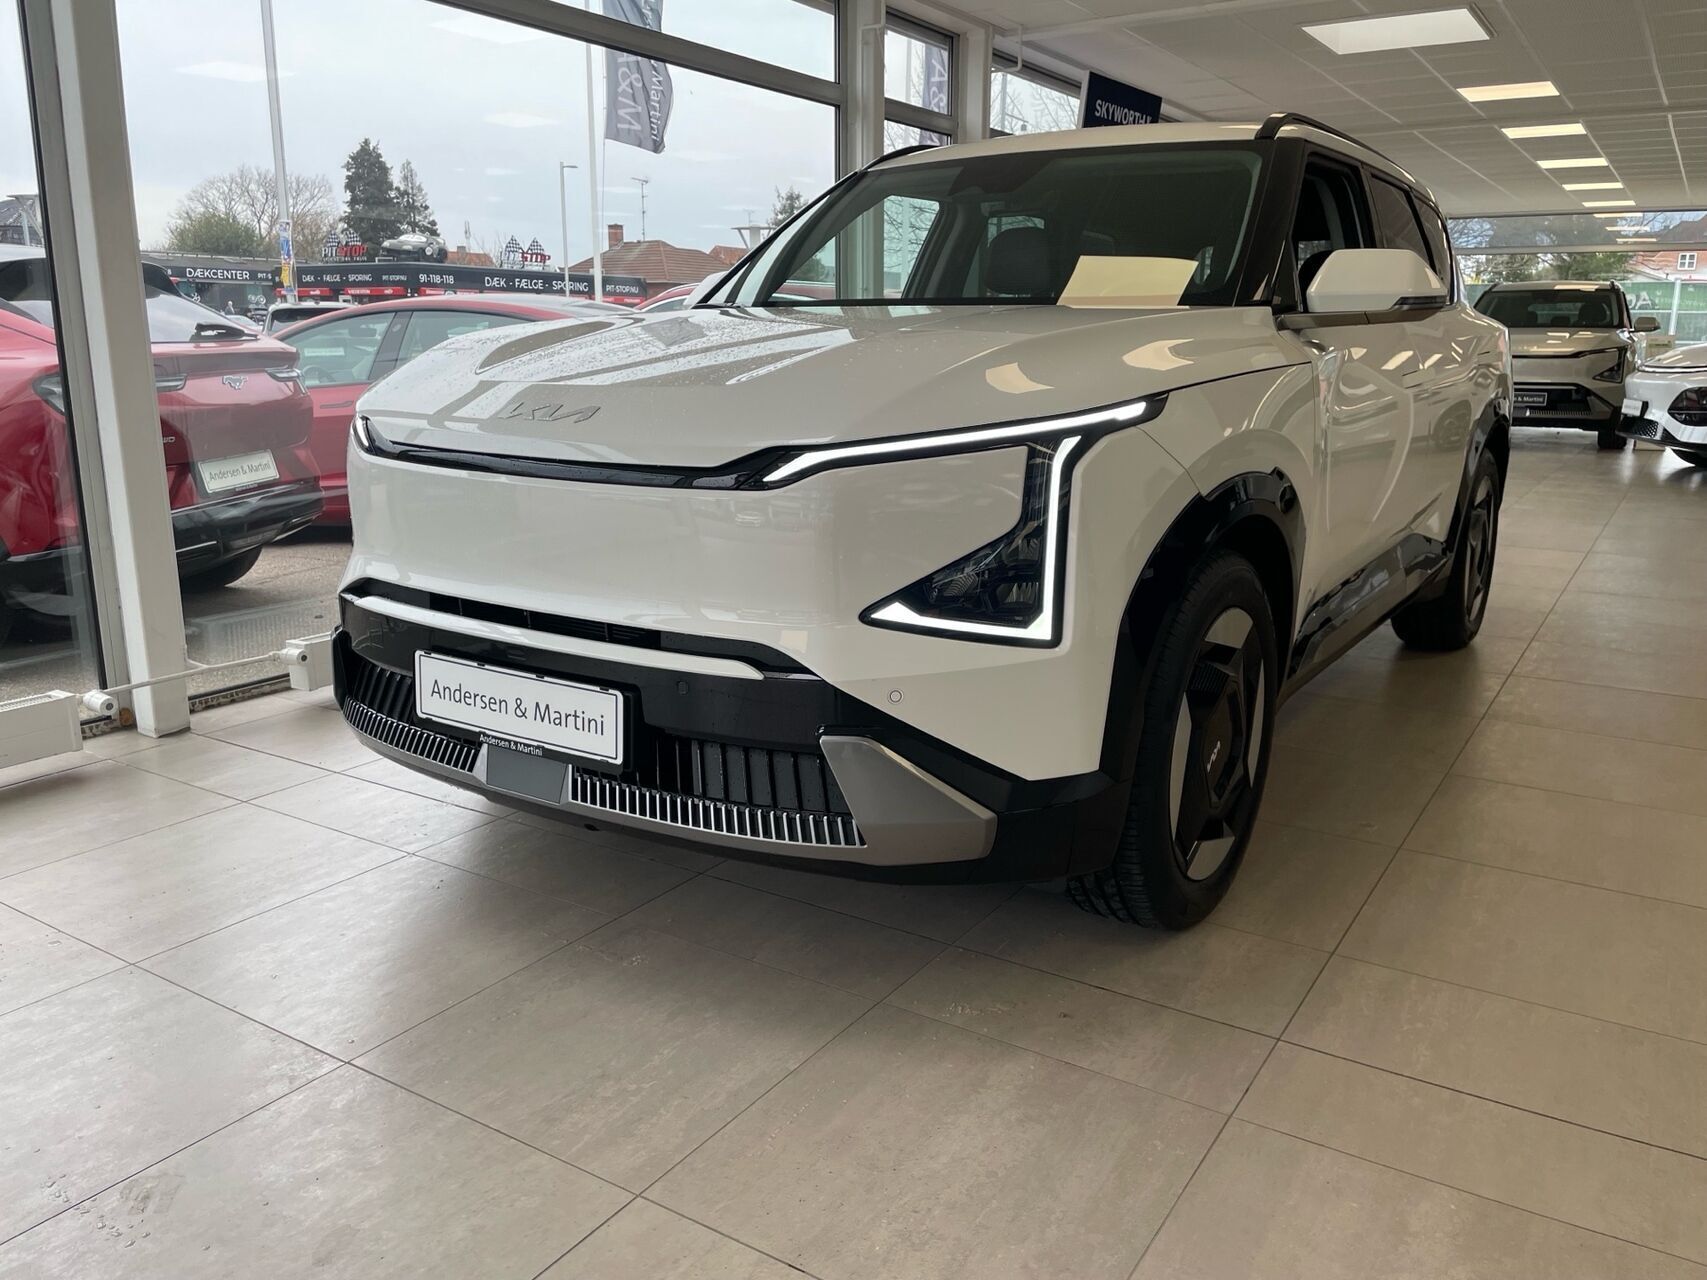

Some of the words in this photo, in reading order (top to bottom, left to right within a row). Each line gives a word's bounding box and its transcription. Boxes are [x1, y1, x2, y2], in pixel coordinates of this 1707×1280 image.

[650, 70, 667, 141] Martini
[1095, 99, 1146, 125] SKYWORTH
[186, 268, 250, 280] DÆKCENTER
[348, 273, 373, 282] SPORING
[419, 274, 454, 284] 91-118-118
[485, 277, 506, 287] DÆK
[515, 279, 543, 290] FÆLGE
[552, 281, 589, 292] SPORING
[209, 468, 241, 481] Andersen
[247, 461, 271, 473] Martini
[431, 679, 508, 715] Andersen
[514, 697, 528, 720] &
[534, 701, 605, 736] Martini
[479, 734, 509, 749] Andersen
[517, 743, 543, 756] Martini
